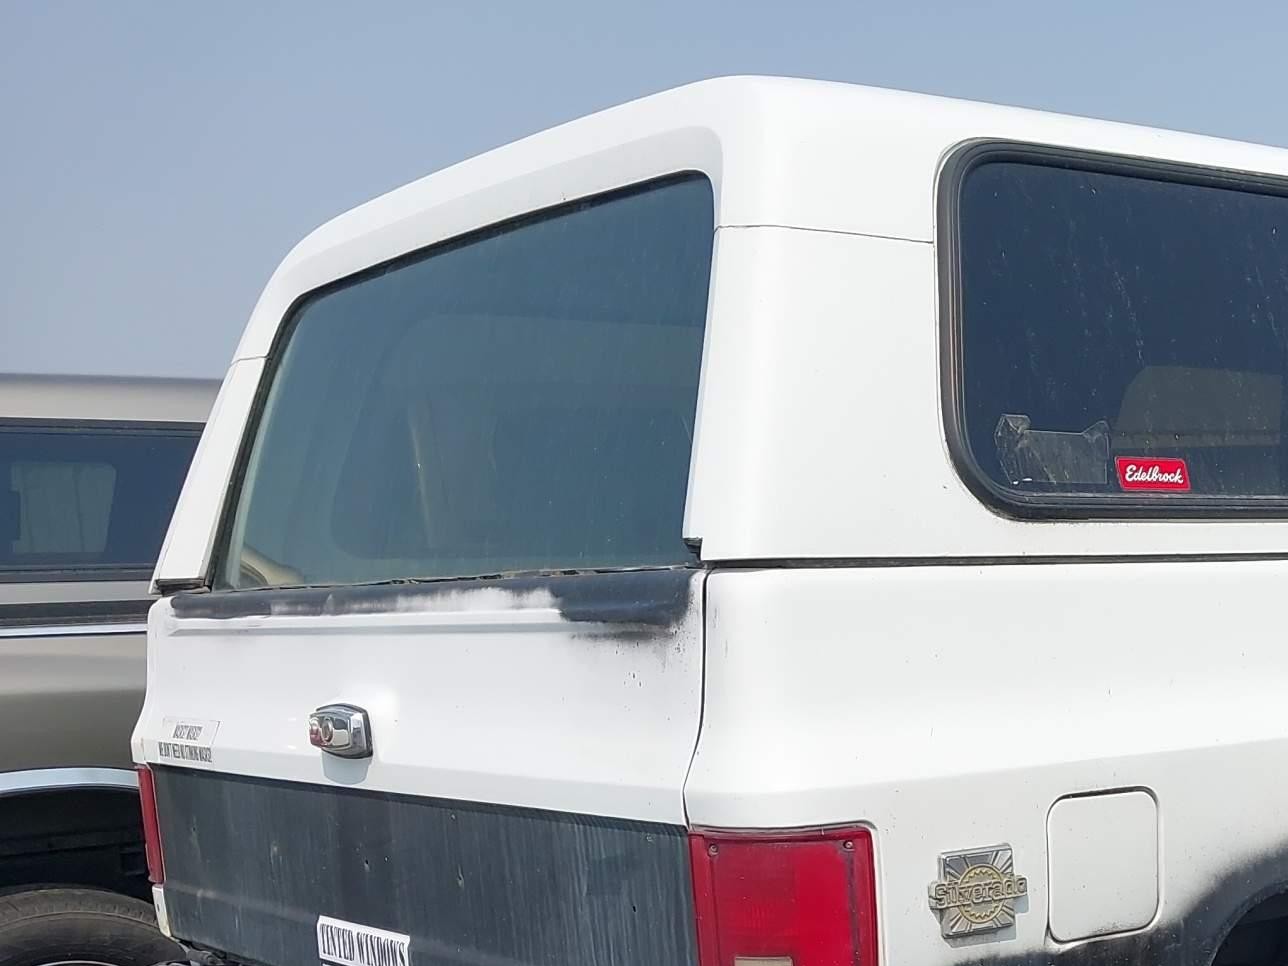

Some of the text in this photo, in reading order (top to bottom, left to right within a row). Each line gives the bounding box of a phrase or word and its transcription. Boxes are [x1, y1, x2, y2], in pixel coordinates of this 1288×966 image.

[1125, 464, 1184, 484] Edelbrock
[934, 876, 1028, 910] Silverado
[320, 923, 355, 962] TINTED
